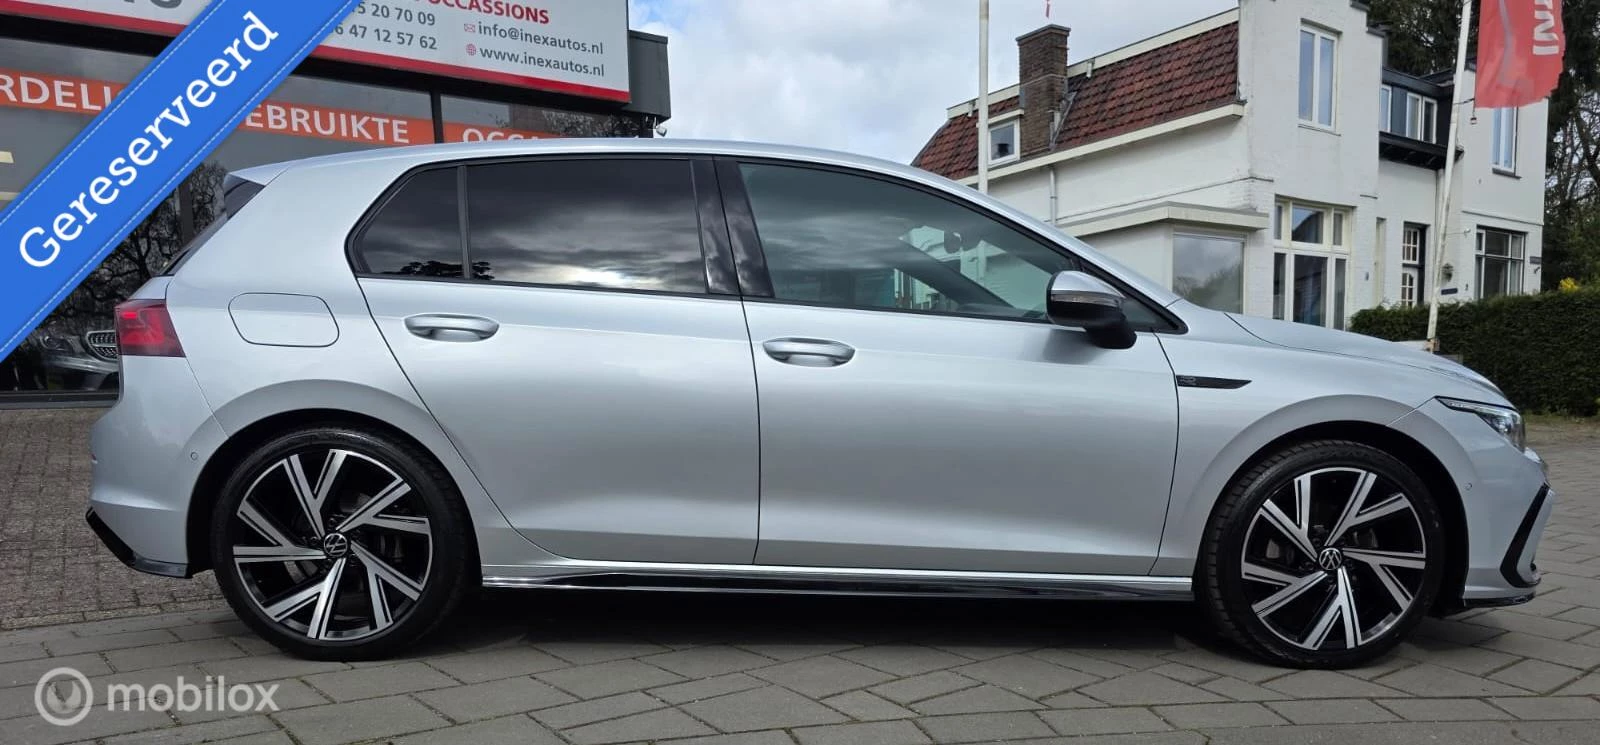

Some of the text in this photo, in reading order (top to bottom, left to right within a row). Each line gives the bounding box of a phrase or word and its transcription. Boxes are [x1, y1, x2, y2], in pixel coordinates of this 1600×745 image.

[371, 3, 390, 18] 20
[395, 8, 413, 22] 70
[417, 11, 435, 26] 09
[427, 0, 550, 24] CCASSIONS
[349, 24, 367, 39] 47
[374, 28, 391, 43] 12
[397, 32, 414, 46] 57
[420, 36, 437, 50] 62
[478, 22, 603, 55] info@inexautos.nl
[480, 47, 605, 77] www.inexautos.nl
[0, 74, 120, 110] RDELI
